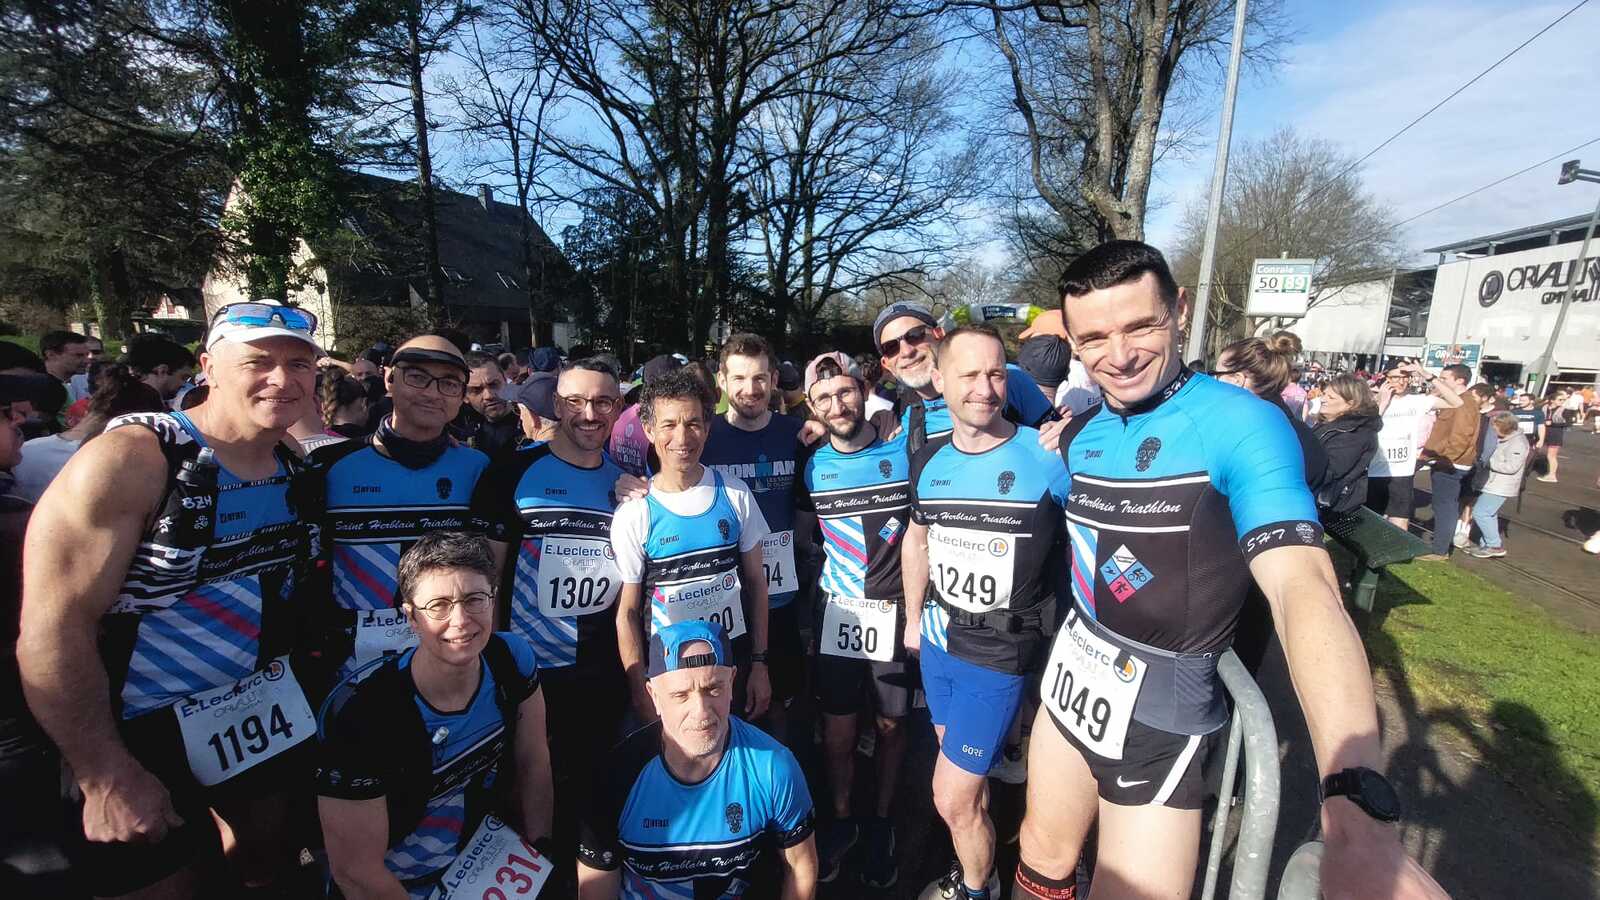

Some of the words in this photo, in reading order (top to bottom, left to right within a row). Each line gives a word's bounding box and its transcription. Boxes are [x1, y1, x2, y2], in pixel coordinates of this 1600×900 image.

[1259, 277, 1278, 288] 50
[1388, 446, 1408, 459] 1183
[815, 502, 832, 510] Saint
[834, 499, 869, 509] Herblain
[872, 493, 908, 503] Triathlon
[1078, 494, 1117, 512] Herblain
[1120, 500, 1181, 514] Triathlon
[336, 521, 364, 531] Saint
[368, 519, 415, 530] Herblain
[420, 518, 464, 528] Triathlon
[530, 519, 556, 528] Saint
[559, 517, 595, 529] Herblain
[940, 512, 977, 521] Herblain
[981, 513, 1022, 525] Triathlon
[928, 529, 986, 552] E.Leclerc
[1247, 529, 1285, 552] SHT
[545, 545, 601, 557] E.Leclerc
[661, 567, 679, 576] Saint
[681, 562, 711, 571] Herblain
[550, 577, 610, 609] 1302
[668, 584, 721, 604] E.Leclerc
[938, 563, 996, 605] 1249
[362, 614, 407, 628] E.Lecl
[838, 622, 877, 653] 530
[1065, 619, 1110, 666] Leclerc
[181, 678, 262, 718] E.Leclerc
[1051, 662, 1111, 742] 1049
[208, 703, 293, 771] 1194
[962, 744, 984, 757] GORE
[628, 857, 655, 871] Saint
[659, 860, 706, 872] Herblain
[712, 852, 746, 866] Triath
